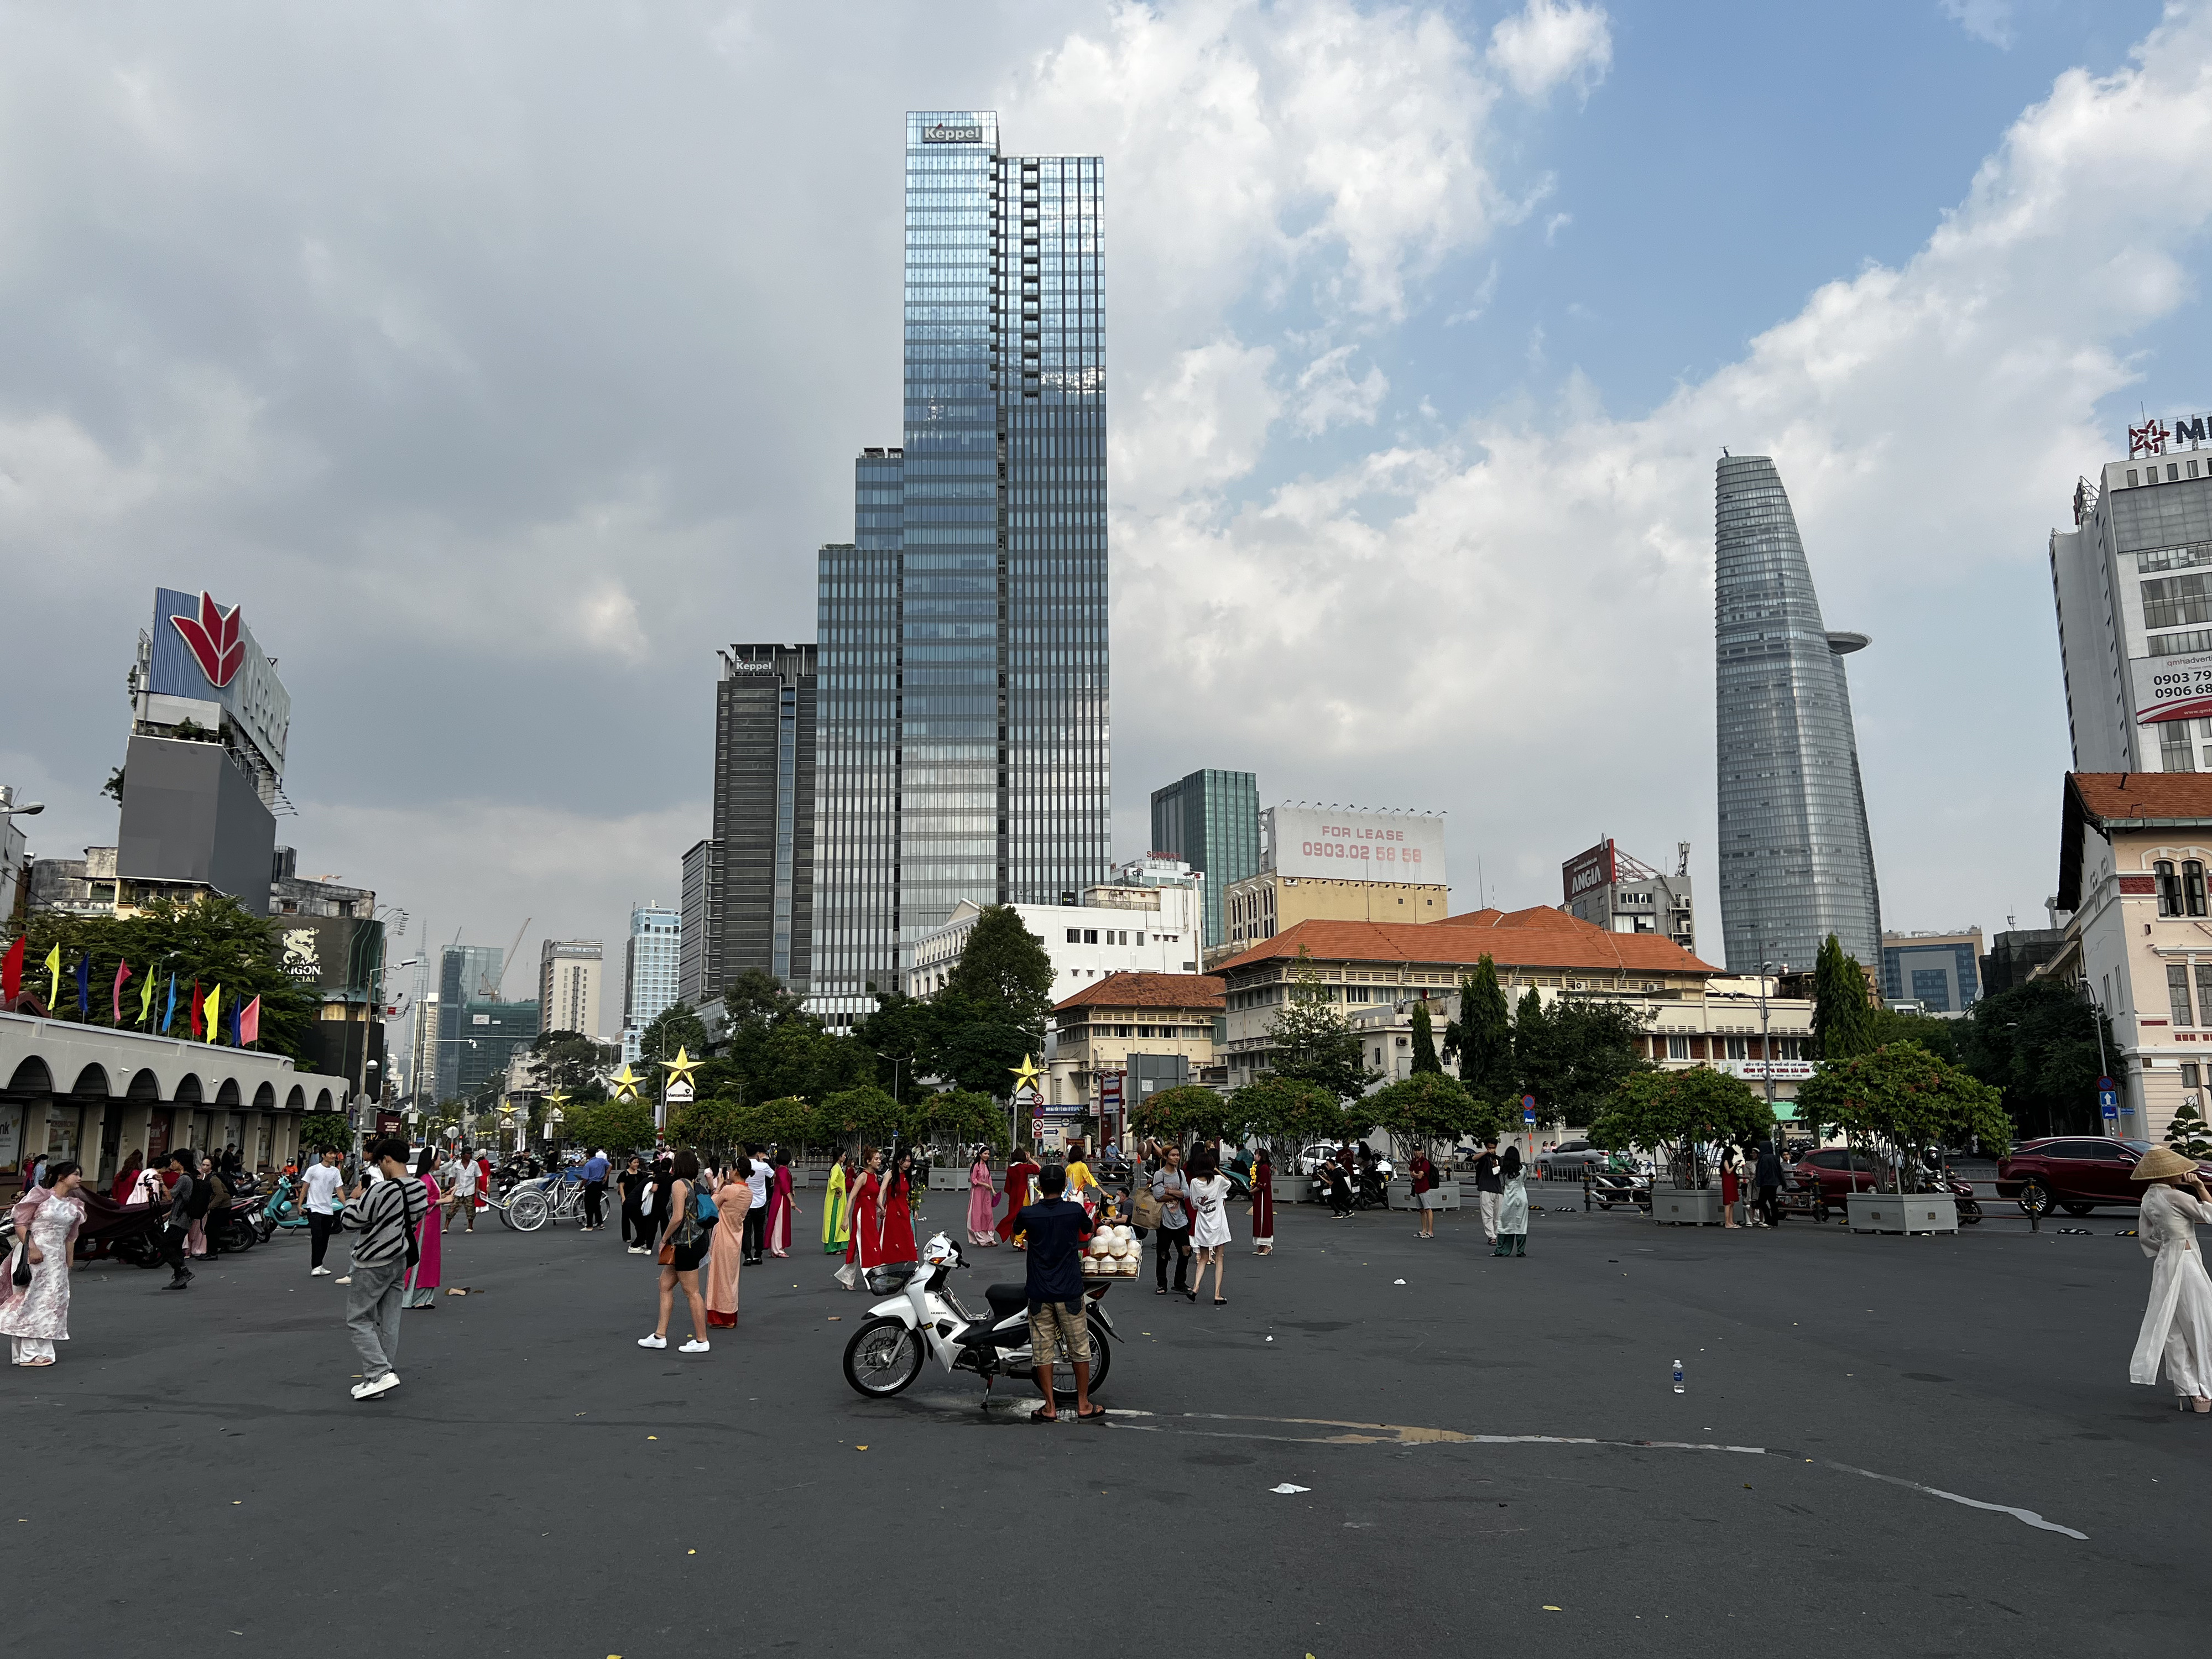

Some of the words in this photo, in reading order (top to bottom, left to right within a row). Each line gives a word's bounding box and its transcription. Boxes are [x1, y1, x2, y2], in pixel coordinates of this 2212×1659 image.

[925, 127, 979, 140] Keppel
[2176, 416, 2212, 444] M
[736, 662, 772, 671] Keppel
[2153, 672, 2190, 685] 0903
[2194, 670, 2212, 681] 79
[2155, 686, 2192, 698] 0906
[1322, 826, 1351, 838] FOR
[1357, 828, 1404, 841] LEASE
[1302, 842, 1369, 860] 0903.02
[1376, 847, 1396, 861] 58
[1402, 848, 1422, 863] 58
